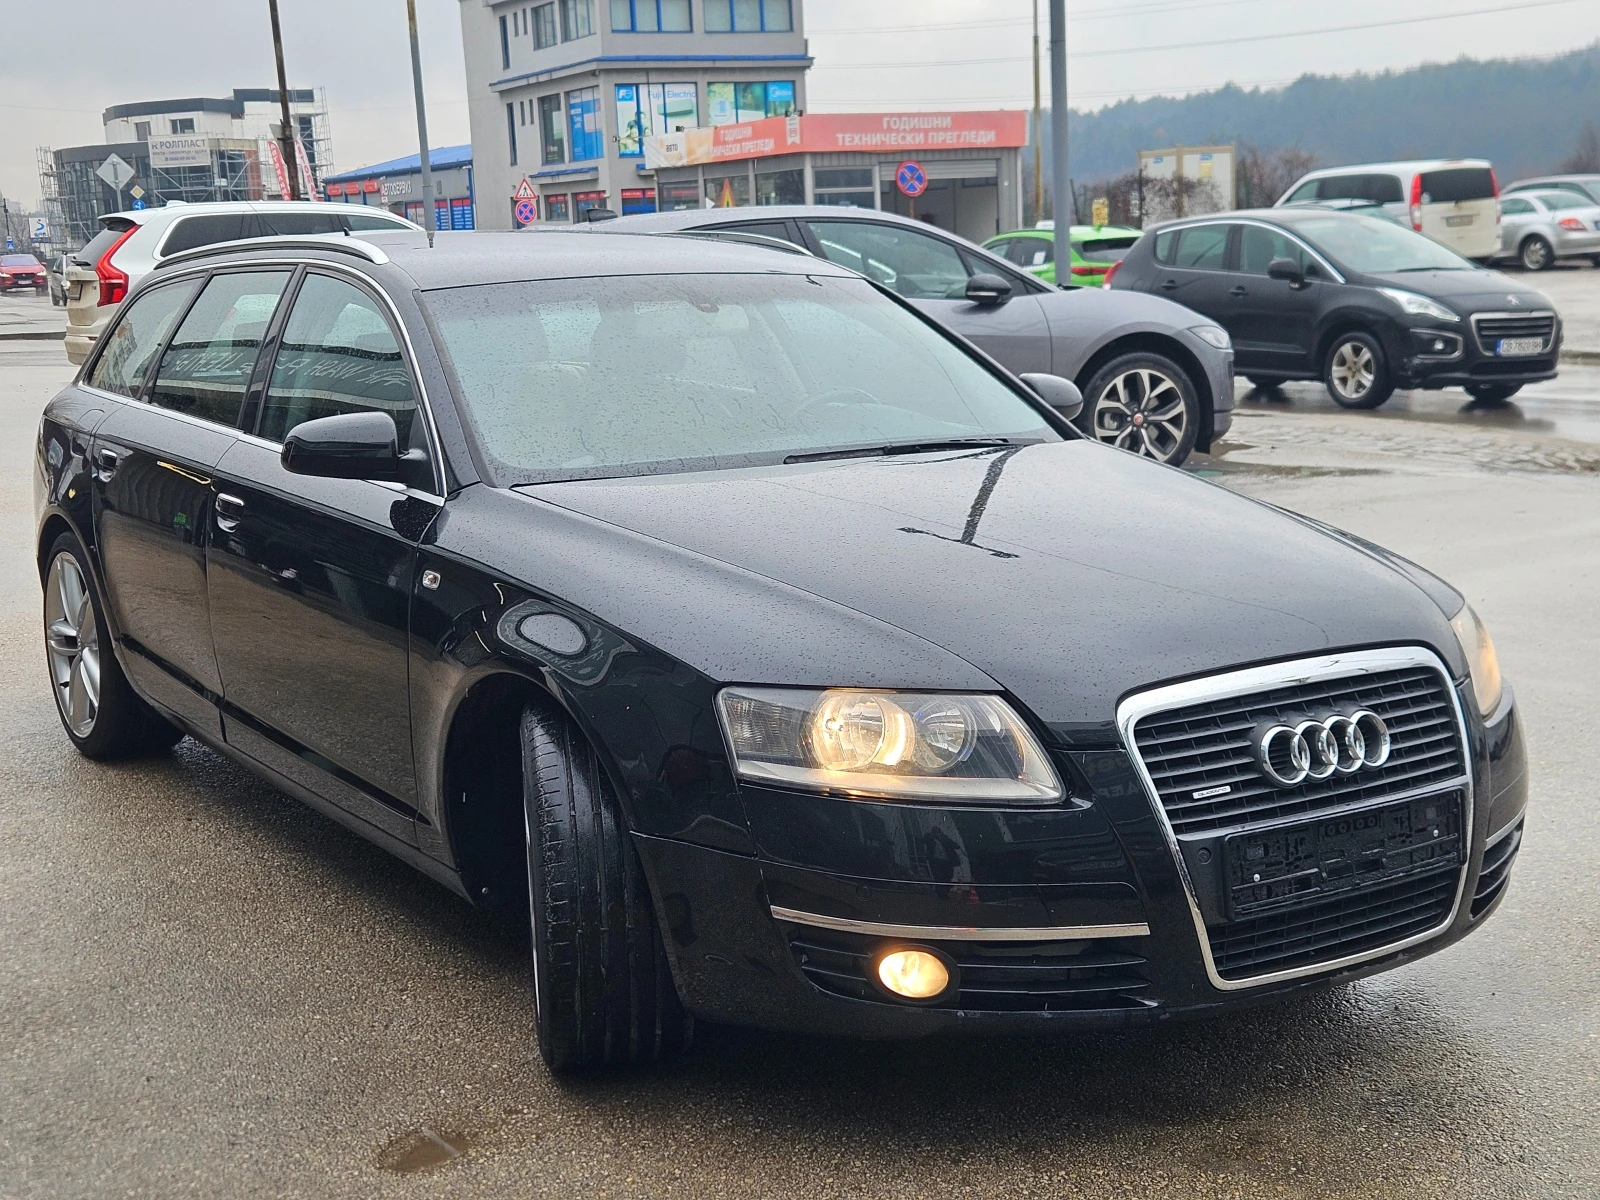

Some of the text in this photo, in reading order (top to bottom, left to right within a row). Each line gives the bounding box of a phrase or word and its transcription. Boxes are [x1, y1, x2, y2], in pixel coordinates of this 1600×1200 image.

[649, 90, 697, 100] Fuji Electric
[882, 116, 952, 131] ГОДИШНИ
[160, 139, 206, 149] РОЛПЛАСТ
[836, 130, 996, 147] ТЕХНИЧЕСКИ ПРЕГЛЕДИ
